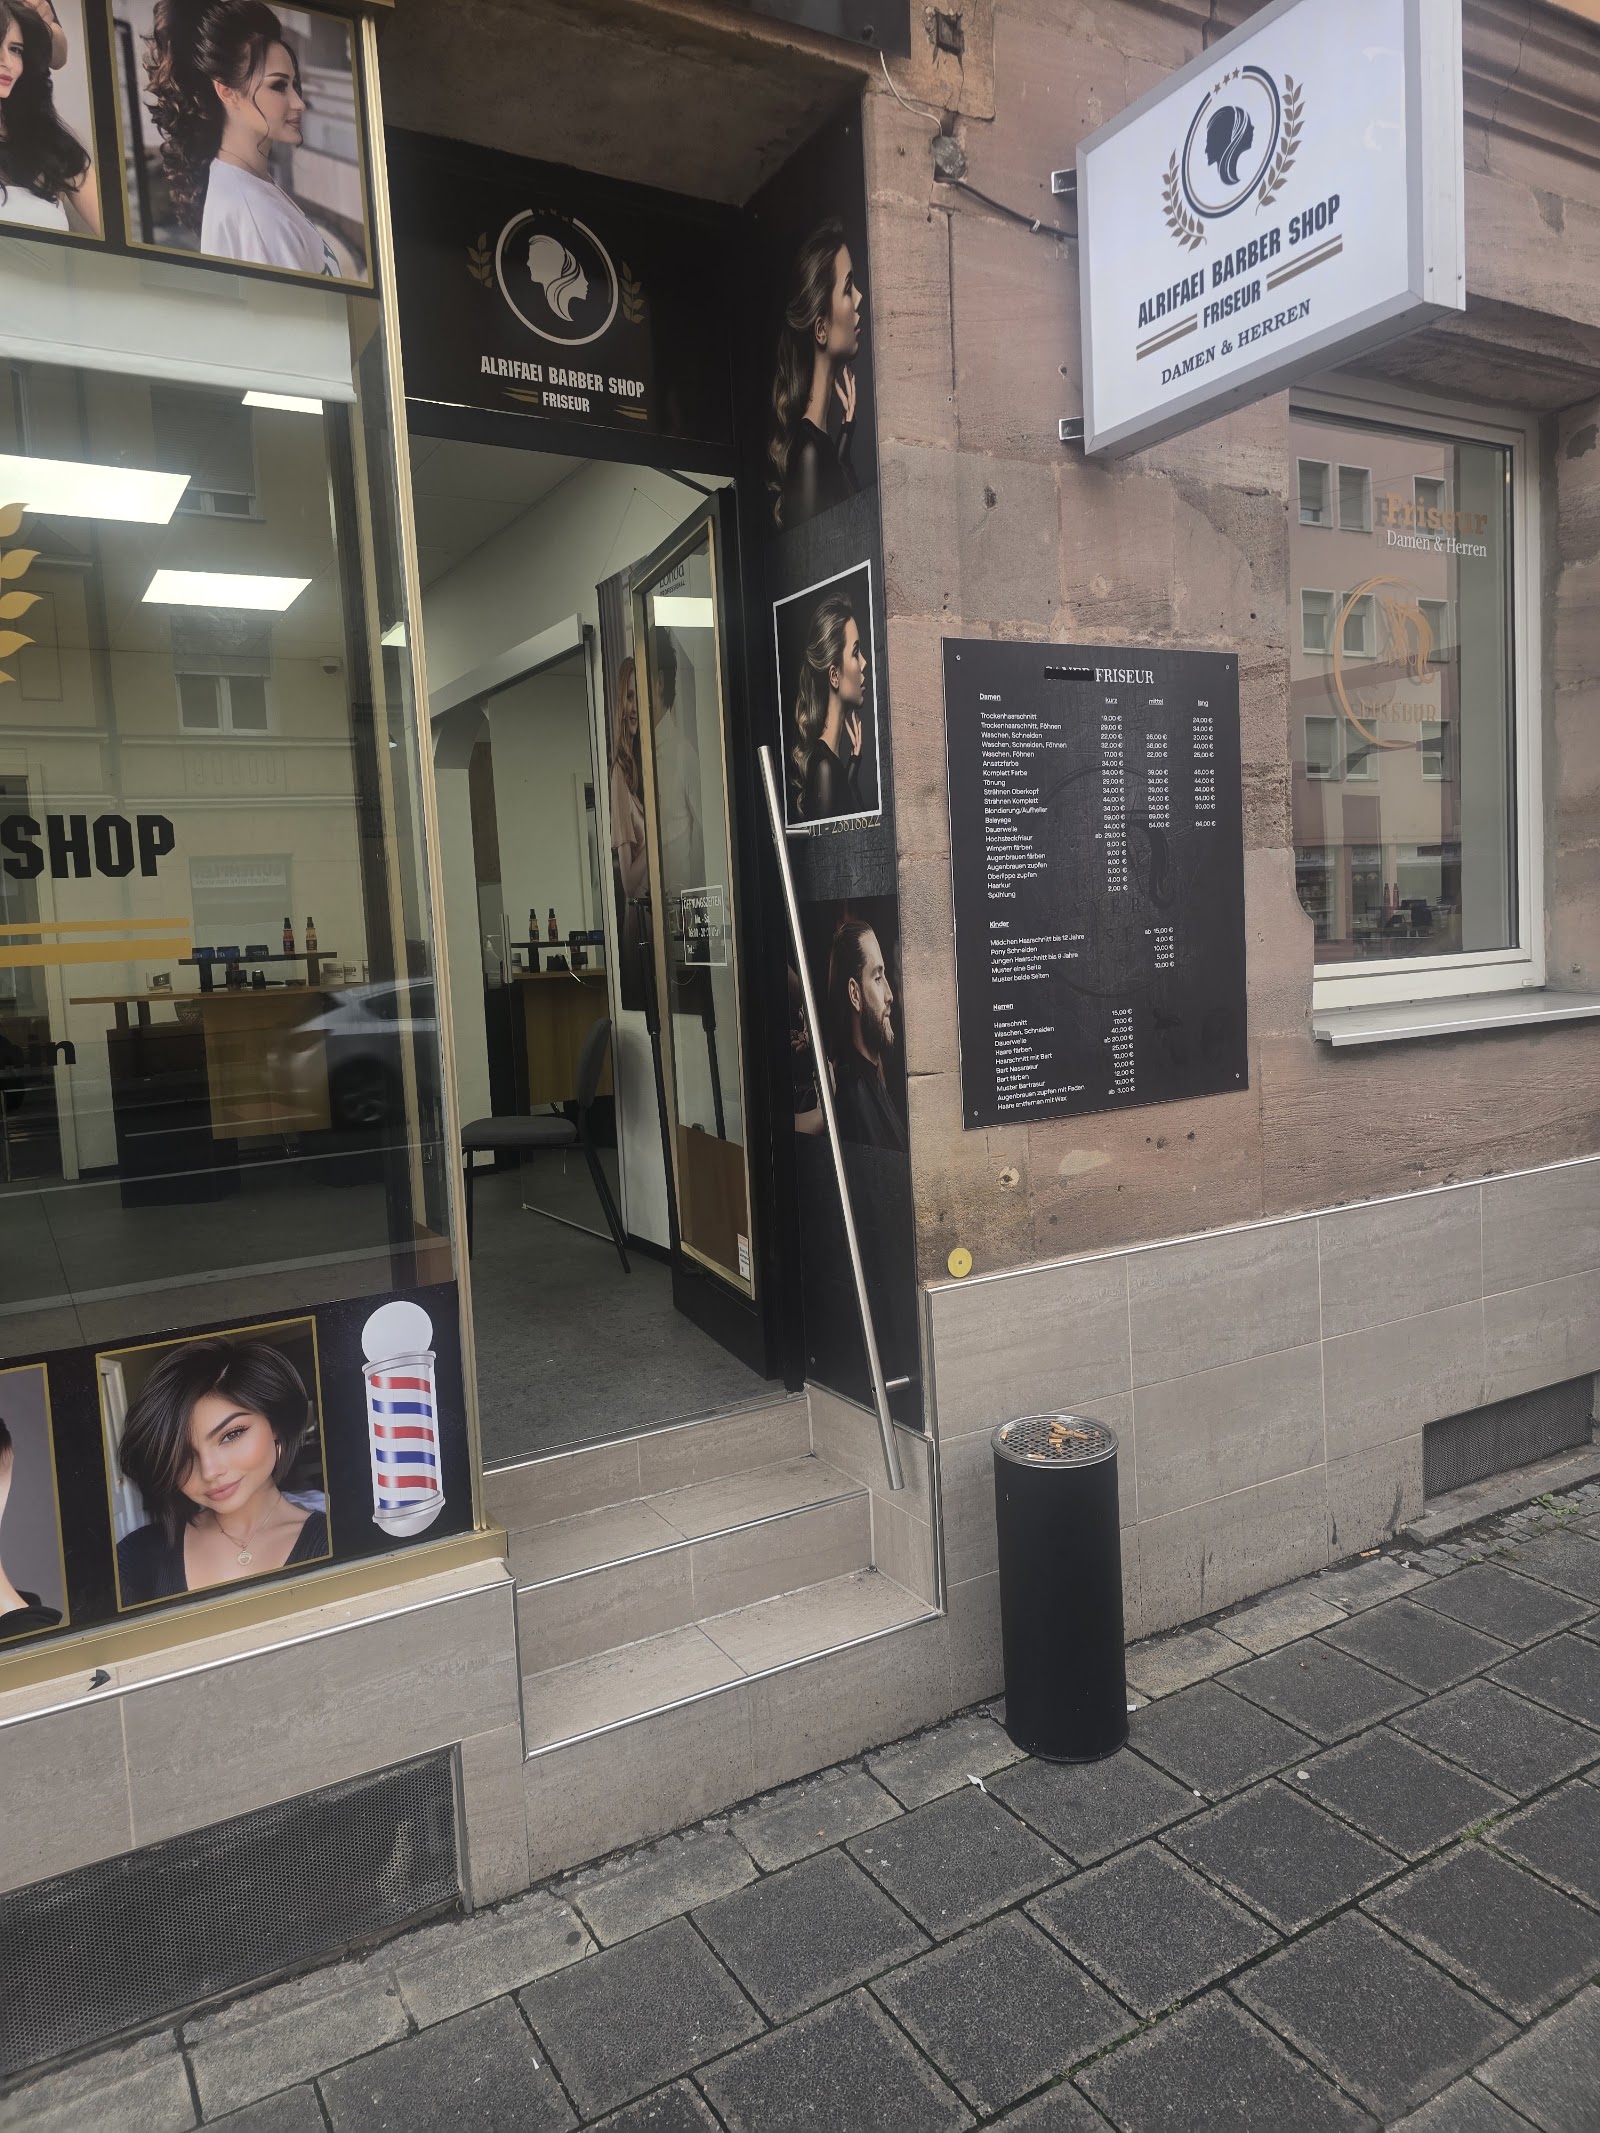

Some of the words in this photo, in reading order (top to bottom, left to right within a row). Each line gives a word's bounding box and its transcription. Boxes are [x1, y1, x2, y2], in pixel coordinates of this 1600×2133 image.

[1138, 268, 1204, 329] ALRIFAEI
[1212, 227, 1280, 289] BARBER
[1289, 194, 1340, 246] SHOP
[1203, 279, 1260, 328] FRISEUR
[1161, 345, 1215, 385] DAMEN
[1221, 339, 1233, 355] &
[1238, 298, 1311, 348] HERREN
[481, 355, 543, 382] ALRIFAEI
[548, 367, 603, 392] BARBER
[609, 376, 644, 398] SHOP
[542, 392, 590, 413] FRISEUR
[1387, 492, 1488, 535] Friseur
[1387, 530, 1430, 550] Damen
[1434, 536, 1443, 551] &
[1447, 538, 1487, 557] Herren
[980, 693, 1001, 701] Damen
[1095, 668, 1154, 684] FRISEUR
[1, 814, 175, 879] SHOP
